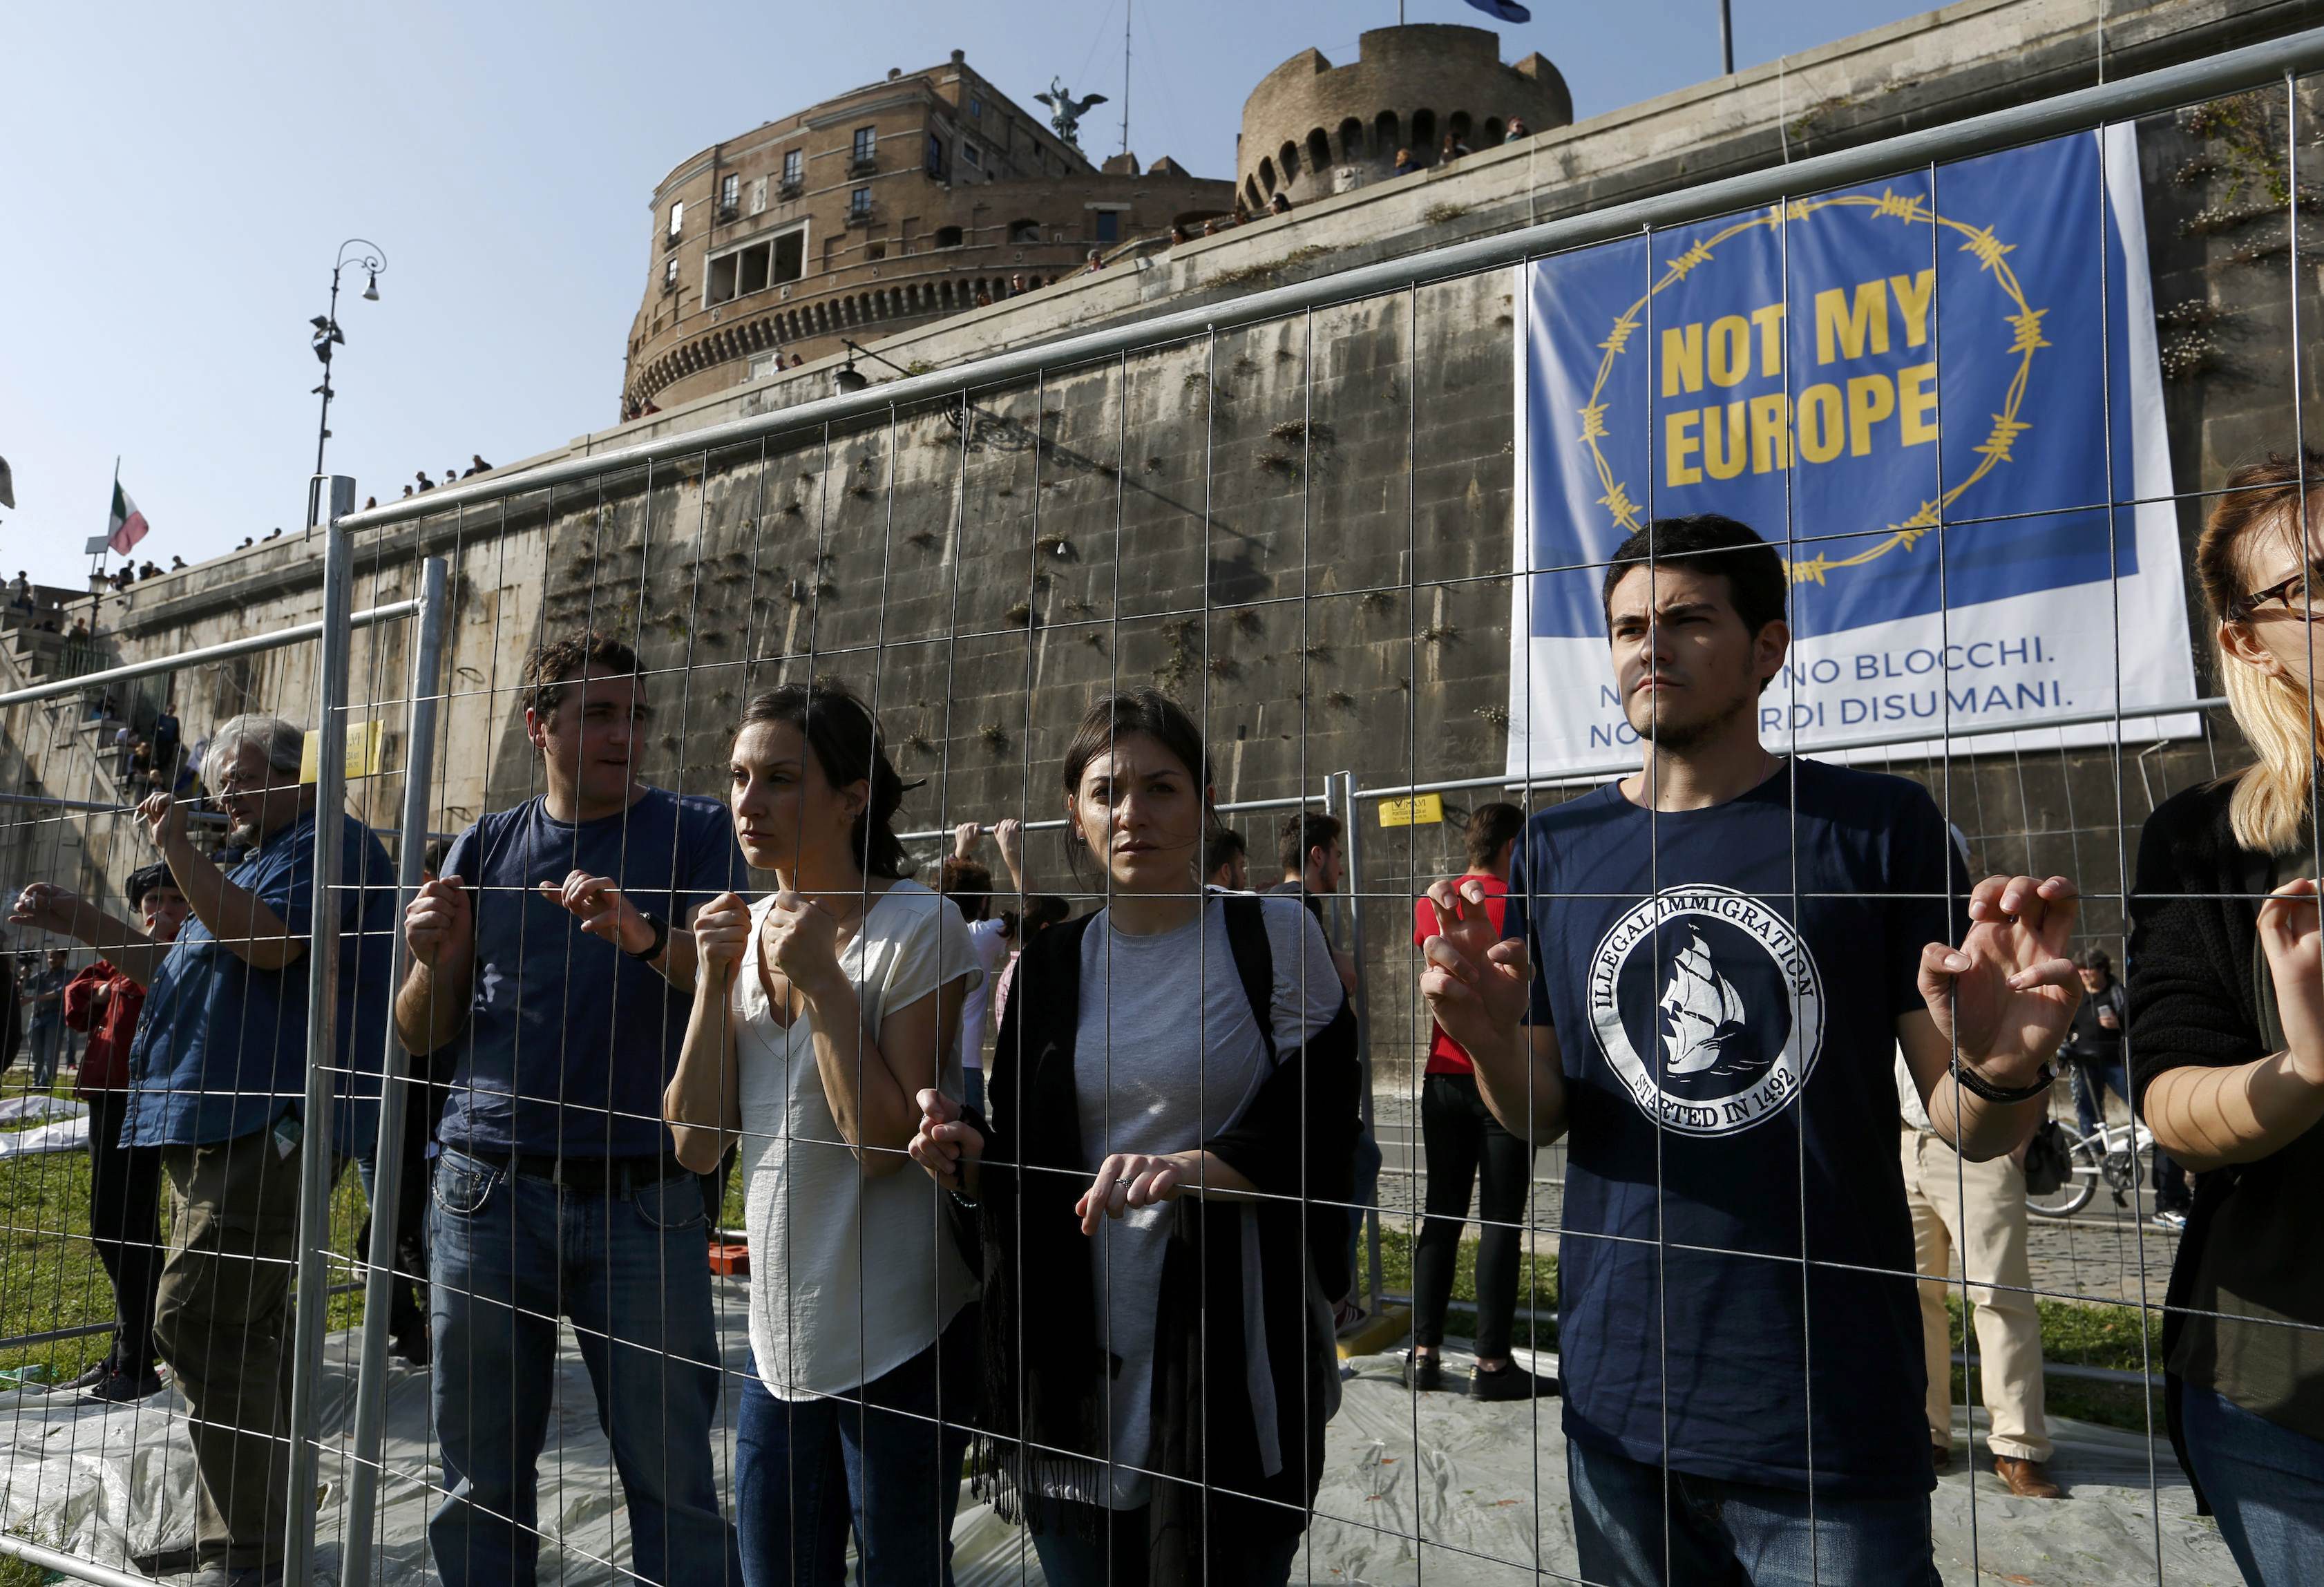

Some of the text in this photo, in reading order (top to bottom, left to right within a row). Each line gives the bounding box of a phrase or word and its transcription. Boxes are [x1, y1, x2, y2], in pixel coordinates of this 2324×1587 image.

[1662, 268, 1936, 398] NOT MY
[1666, 361, 1942, 488] EUROPE
[1782, 659, 1840, 690] NO
[1856, 636, 2055, 681] BLOCCHI.
[1841, 680, 2073, 725] DISUMANI.
[1594, 893, 1814, 1009] ILLEGAL IMMIGRATION
[1635, 1067, 1796, 1128] STARTED IN 1492
